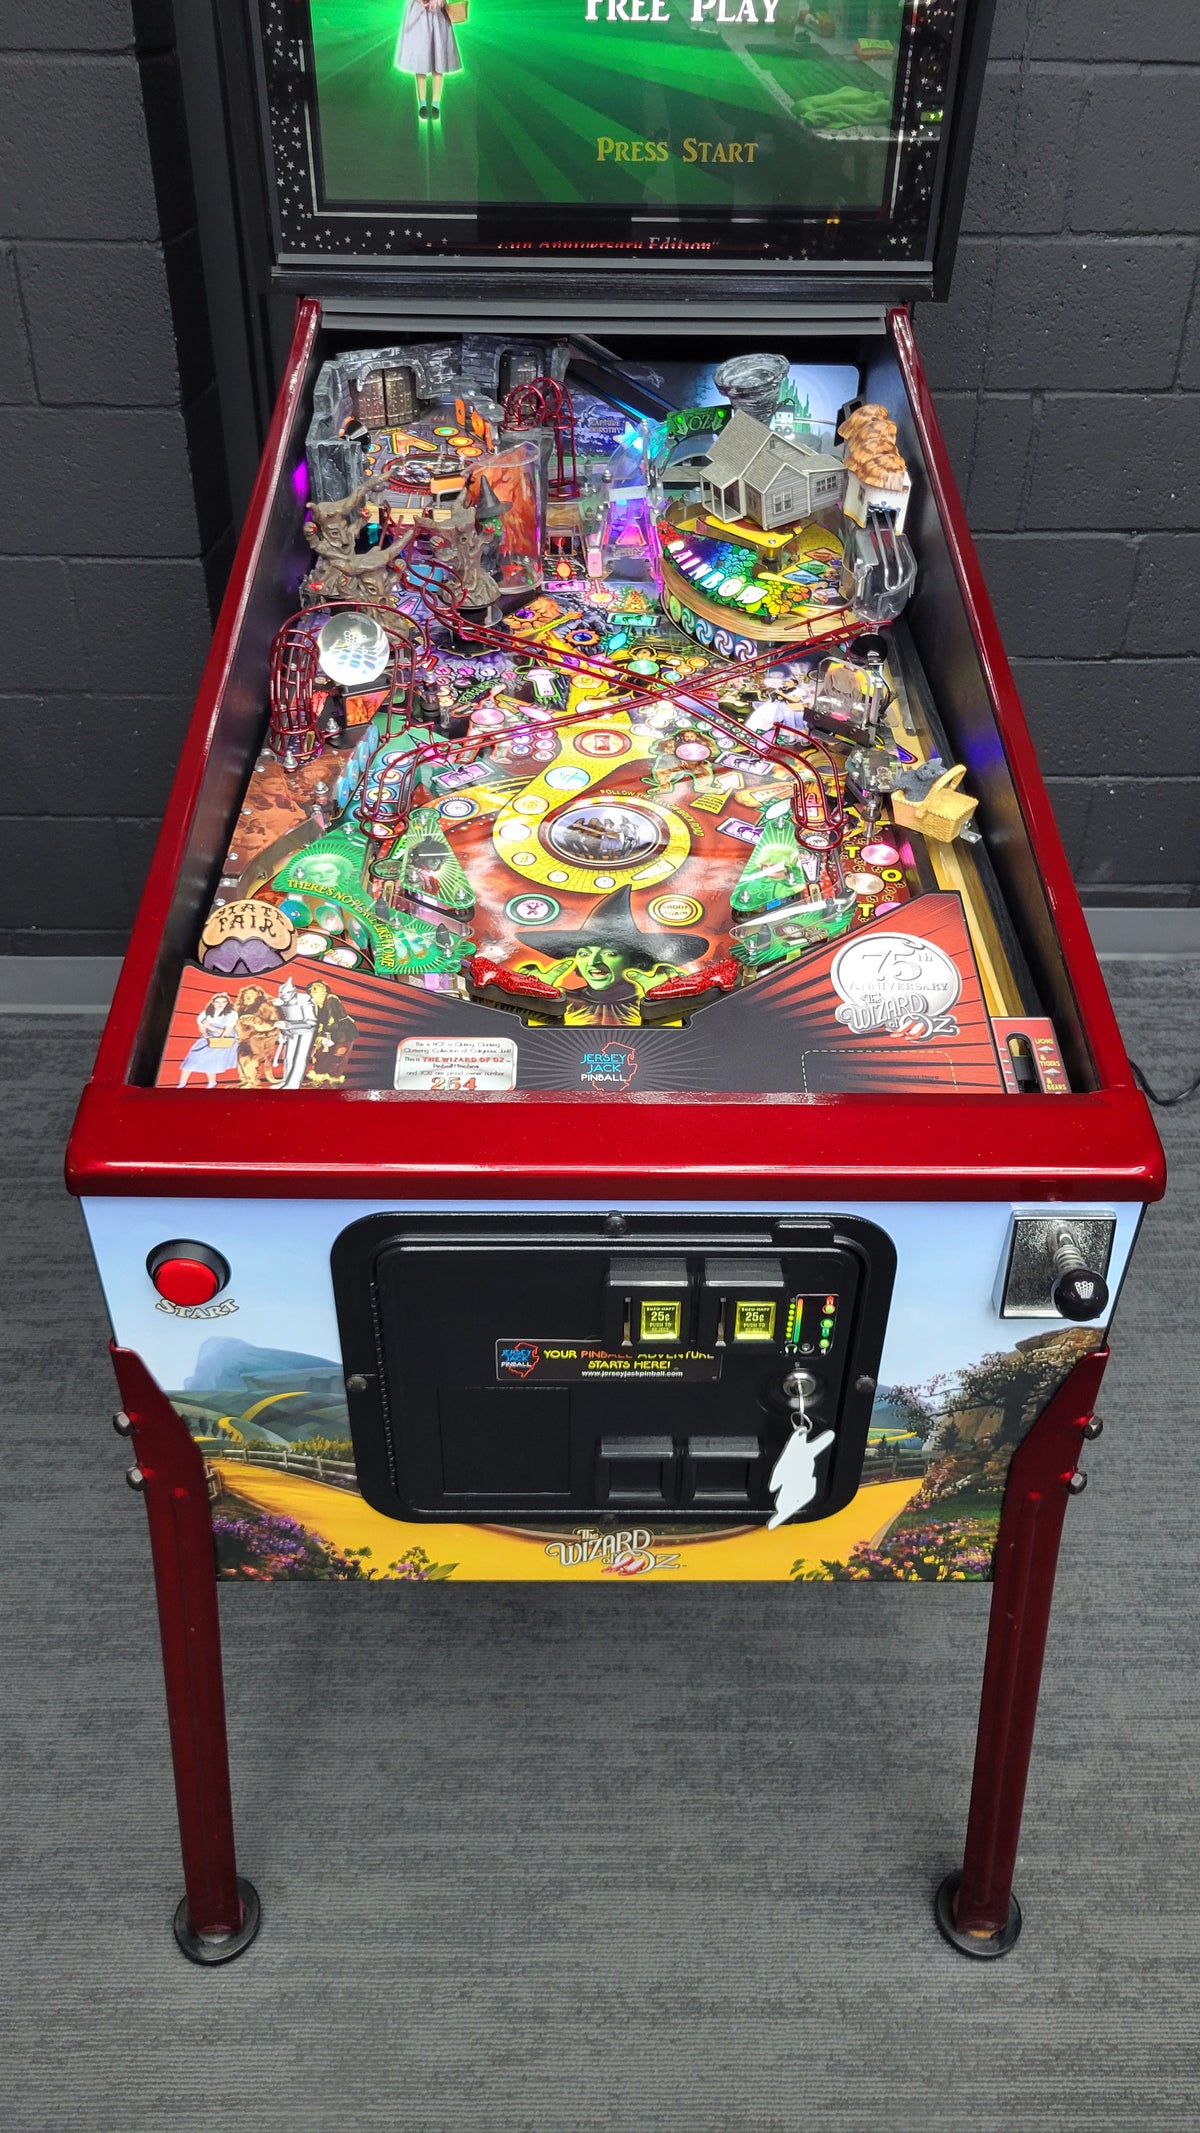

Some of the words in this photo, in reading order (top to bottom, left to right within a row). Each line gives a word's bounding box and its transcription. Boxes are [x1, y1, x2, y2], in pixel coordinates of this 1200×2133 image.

[215, 903, 285, 926] STATE
[219, 914, 277, 937] FAIR
[580, 1053, 627, 1064] JERSEY
[586, 1064, 621, 1074] JACK
[581, 1073, 627, 1082] PINBALL
[430, 1076, 477, 1091] 254
[155, 1298, 240, 1320] START
[544, 1350, 577, 1359] YOUR
[588, 1360, 630, 1369] STARTS
[633, 1360, 671, 1369] HERE!
[581, 1370, 683, 1378] www.jerseyjackpinball.com
